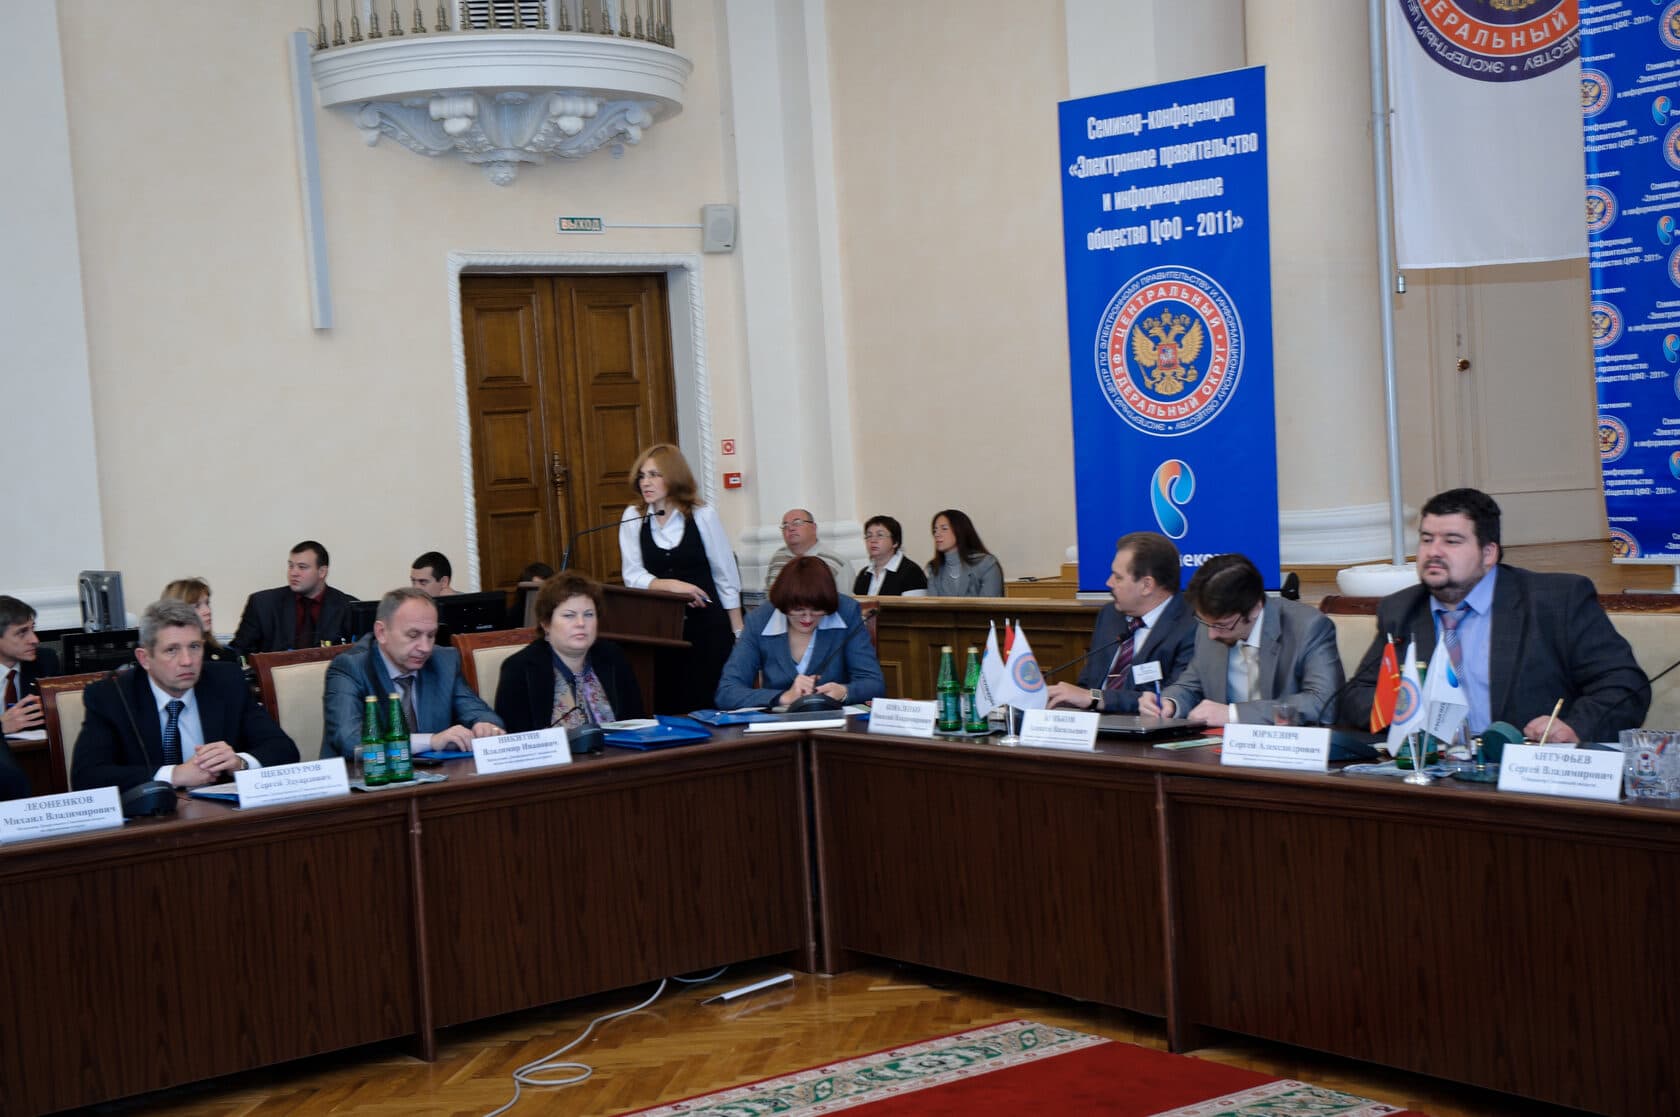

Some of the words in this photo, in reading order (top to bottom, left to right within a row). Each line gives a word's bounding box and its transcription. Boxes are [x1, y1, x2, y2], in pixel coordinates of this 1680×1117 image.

[1424, 0, 1568, 48] ЕРАЛЬНЫЙ
[1416, 20, 1505, 73] ЭКСПЕРТНЫЙ
[1087, 97, 1235, 139] Семинар-конференция
[1069, 148, 1157, 178] «Электронное
[1160, 132, 1258, 168] правительство
[1102, 193, 1112, 212] и
[1114, 176, 1224, 212] информационное
[1087, 224, 1148, 251] общество
[1150, 216, 1182, 245] ЦФО
[1197, 209, 1243, 237] 2011»
[1116, 286, 1221, 338] ЦЕНТРАЛЬНЫЙ
[1112, 354, 1199, 417] ФЕДЕРАЛЬНЫЙ
[1202, 346, 1226, 396] ОКРУГ
[1508, 763, 1539, 775] Сергей
[1542, 766, 1614, 781] Владимирович
[1532, 752, 1592, 765] АНТУФЬЕВ
[3, 815, 43, 826] Михаил
[45, 806, 116, 821] Владимирович
[24, 796, 94, 812] ЛЕОНЕНКОВ
